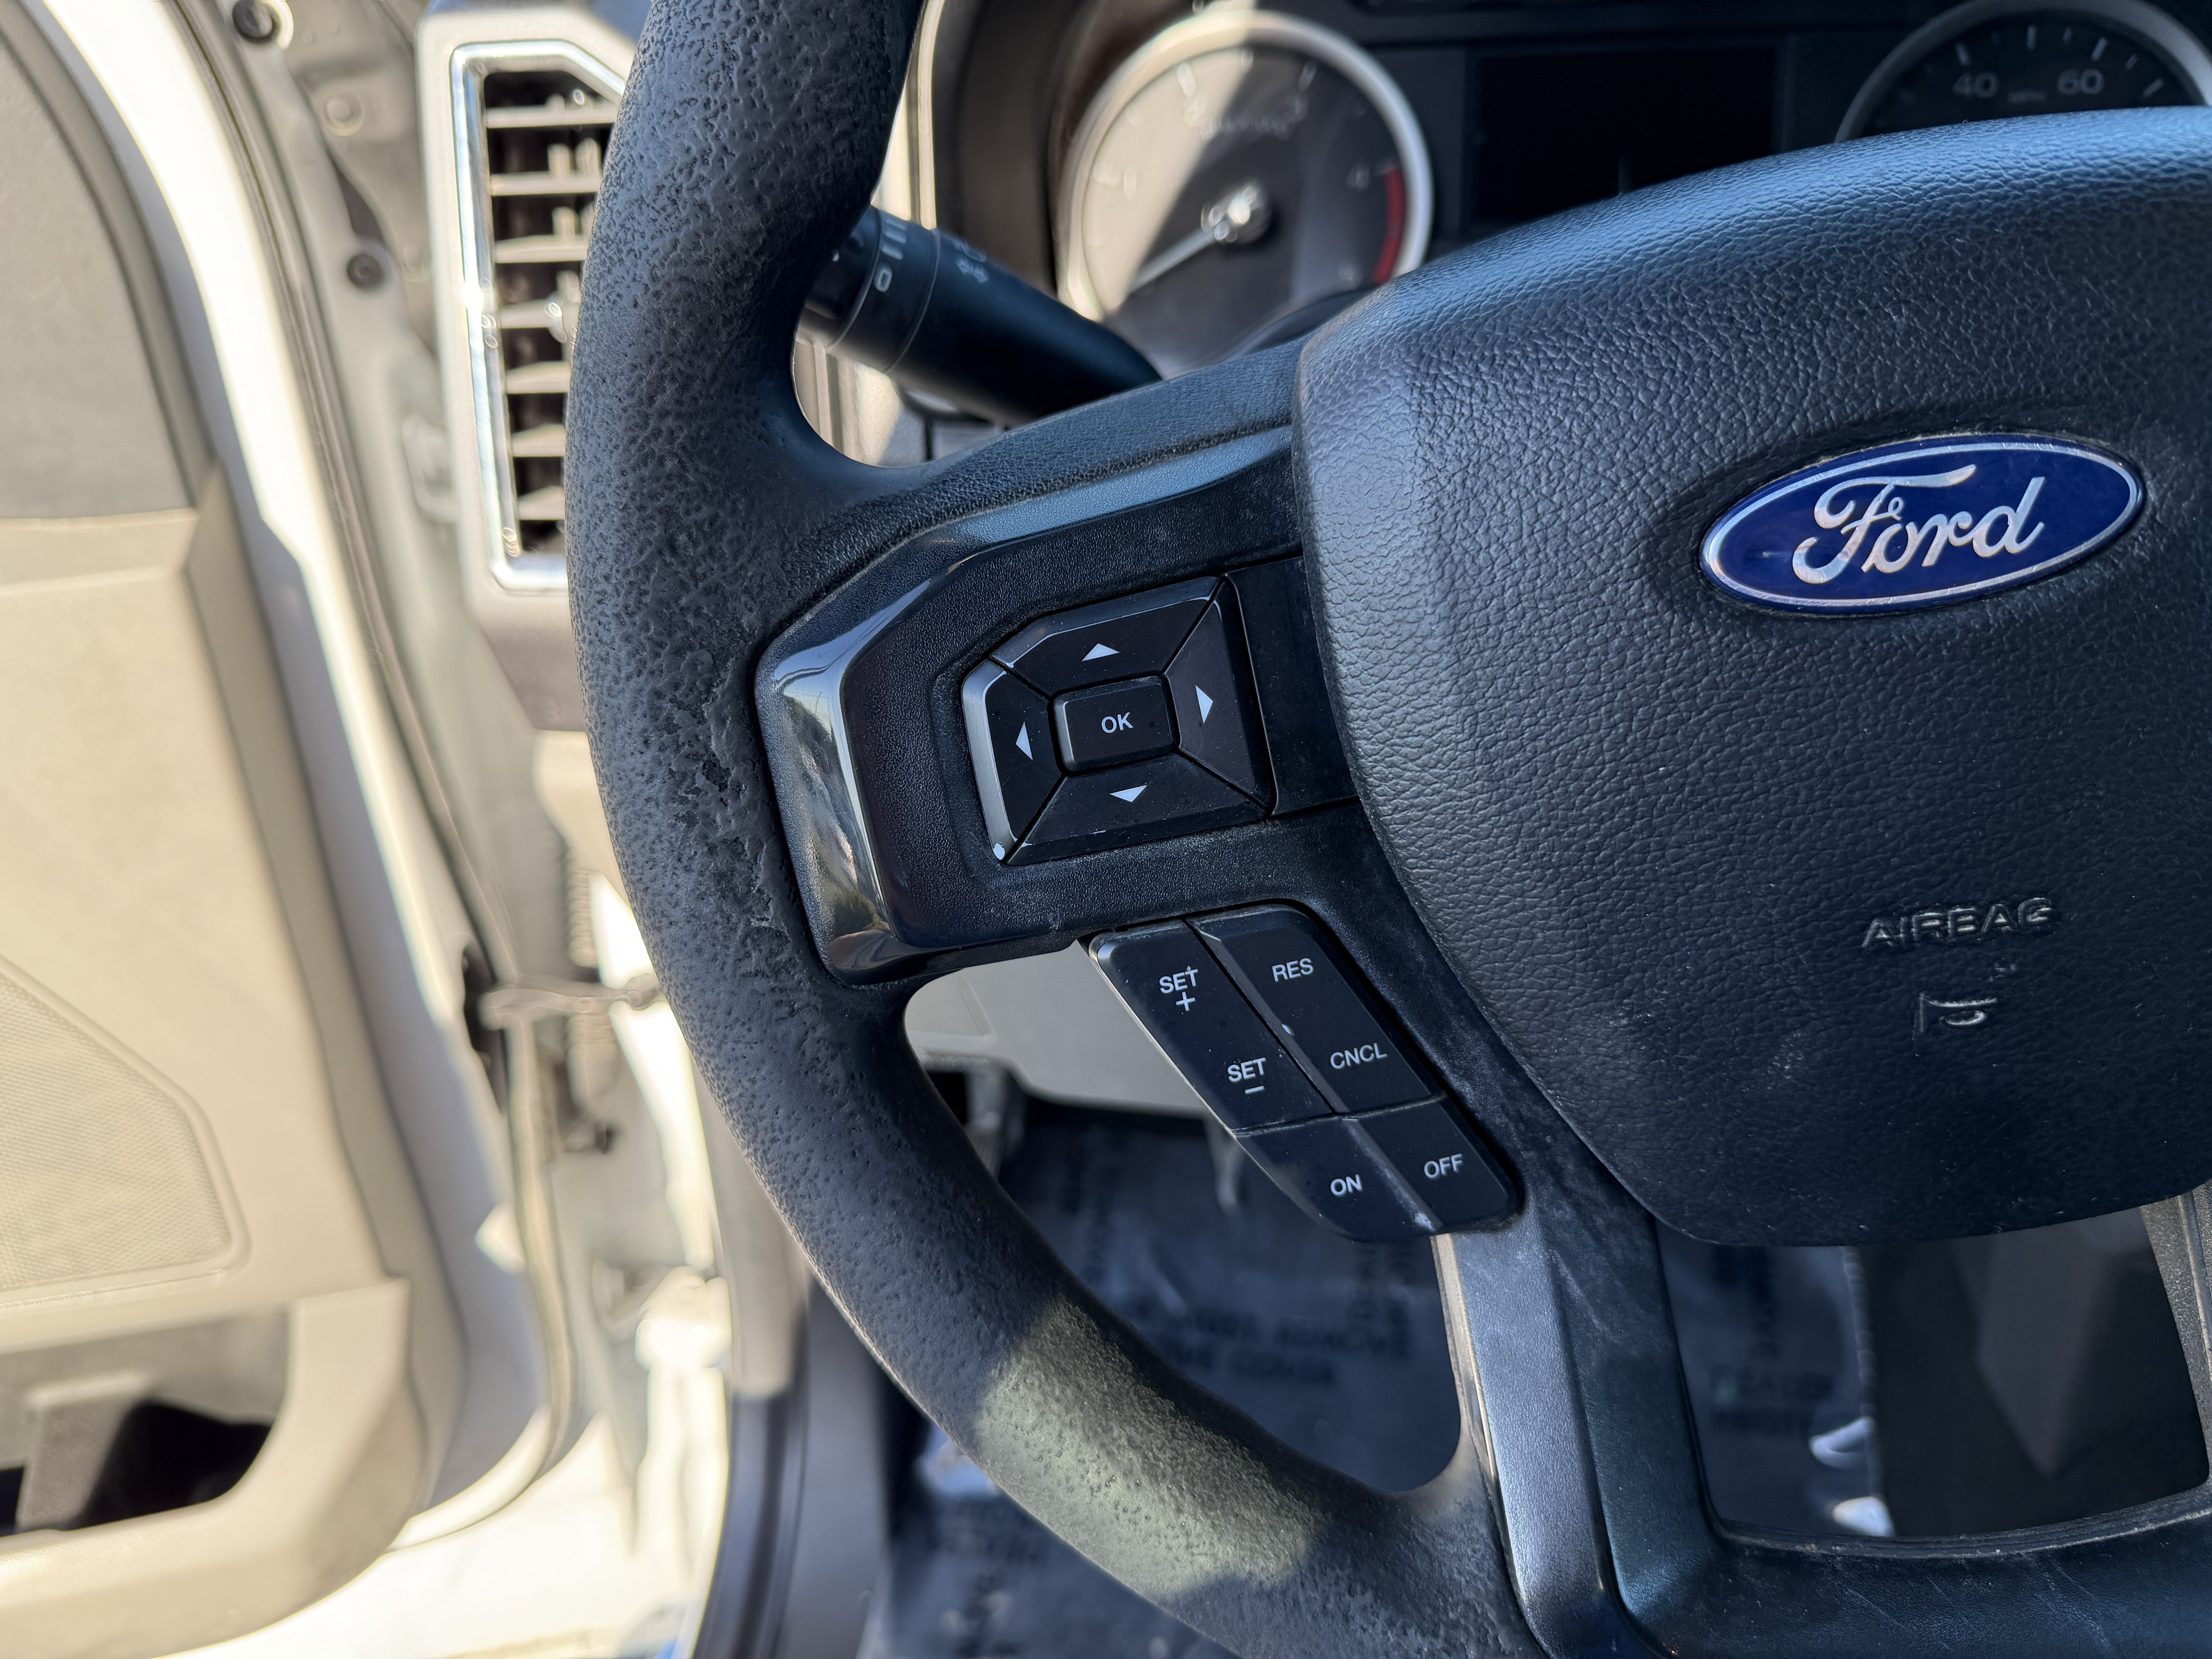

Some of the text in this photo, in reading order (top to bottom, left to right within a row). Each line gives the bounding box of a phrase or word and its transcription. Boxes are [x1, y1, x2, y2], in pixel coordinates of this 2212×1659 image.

[2057, 69, 2105, 96] 60
[1792, 464, 2046, 585] Ford
[1101, 711, 1134, 734] OK
[1861, 897, 2054, 948] AIRBAG
[1158, 968, 1199, 994] SET
[1271, 957, 1314, 982] RES
[1329, 1042, 1388, 1070] CNCL
[1226, 1056, 1267, 1083] SET
[1423, 1153, 1463, 1179] OFF
[1329, 1173, 1363, 1197] ON
